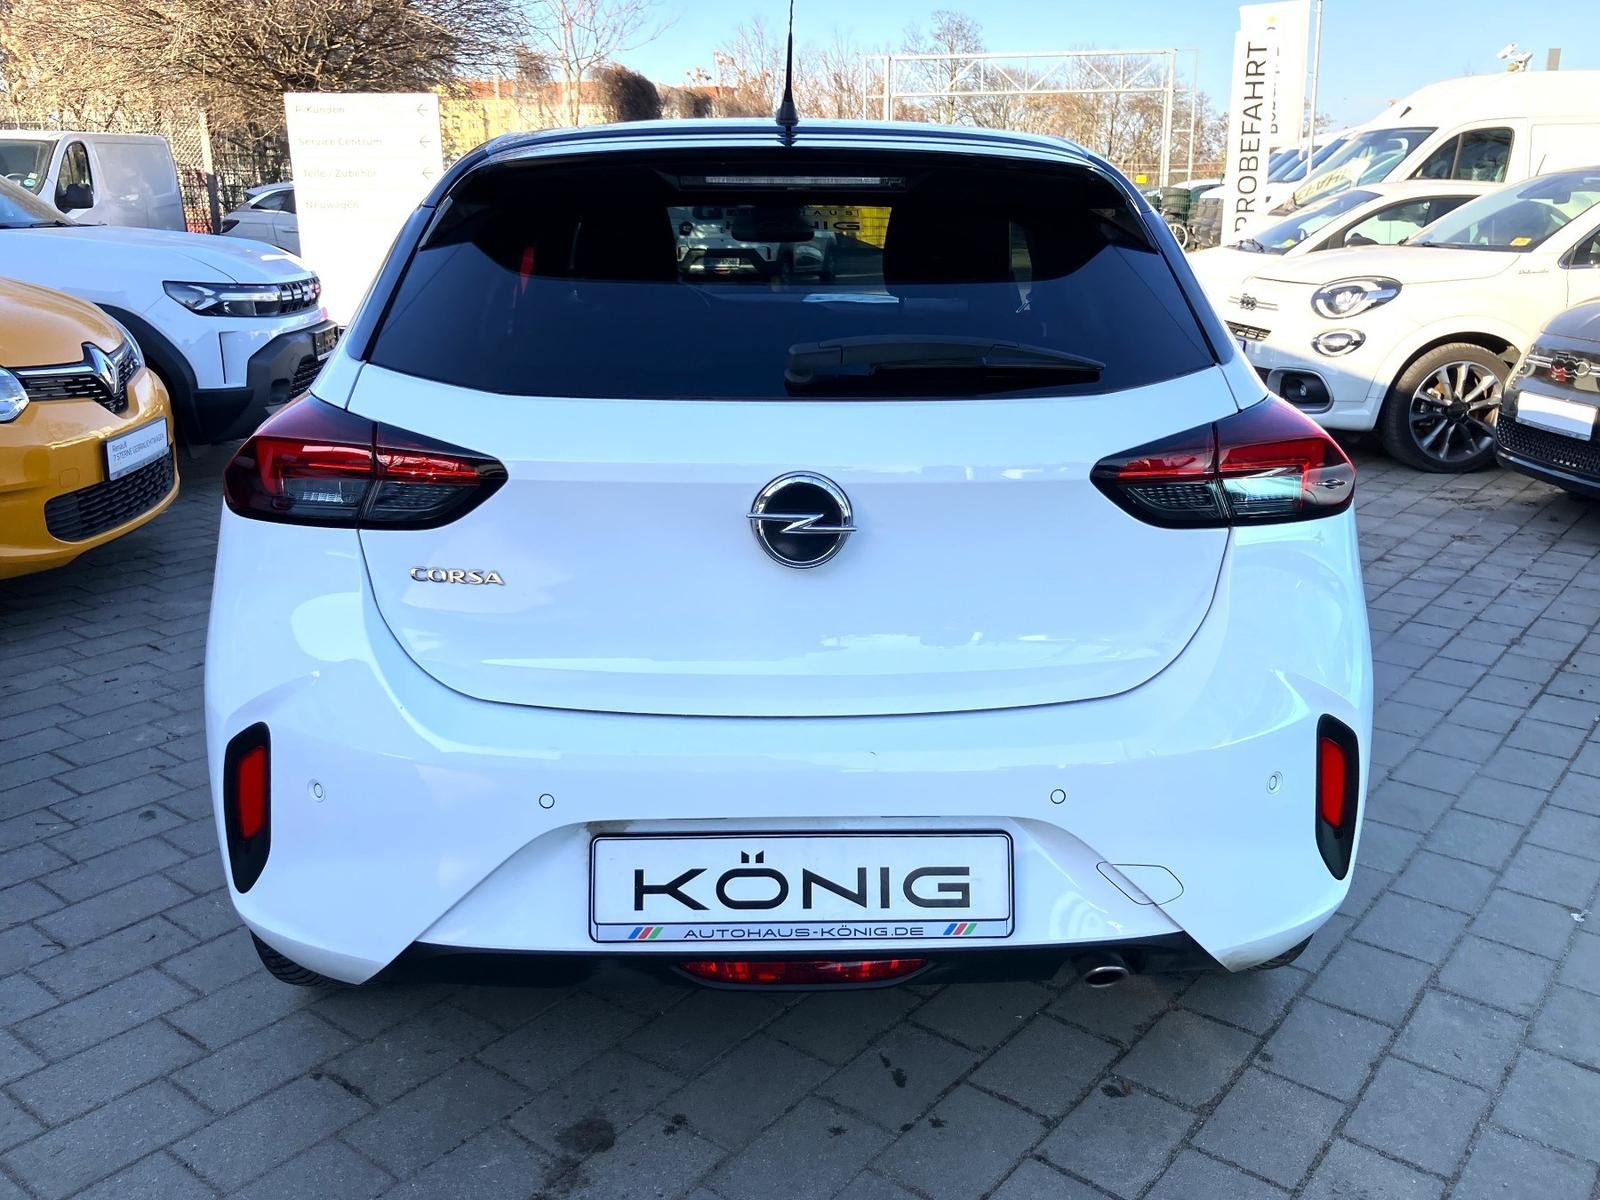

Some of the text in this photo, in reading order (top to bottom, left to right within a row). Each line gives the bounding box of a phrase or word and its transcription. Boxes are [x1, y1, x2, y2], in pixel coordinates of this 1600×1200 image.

[1234, 41, 1267, 232] PROBEFAHRT
[410, 566, 505, 586] CORSA
[633, 850, 970, 911] KÖNIG
[683, 924, 924, 939] AUTOHAUS-KÖNIG.DE
